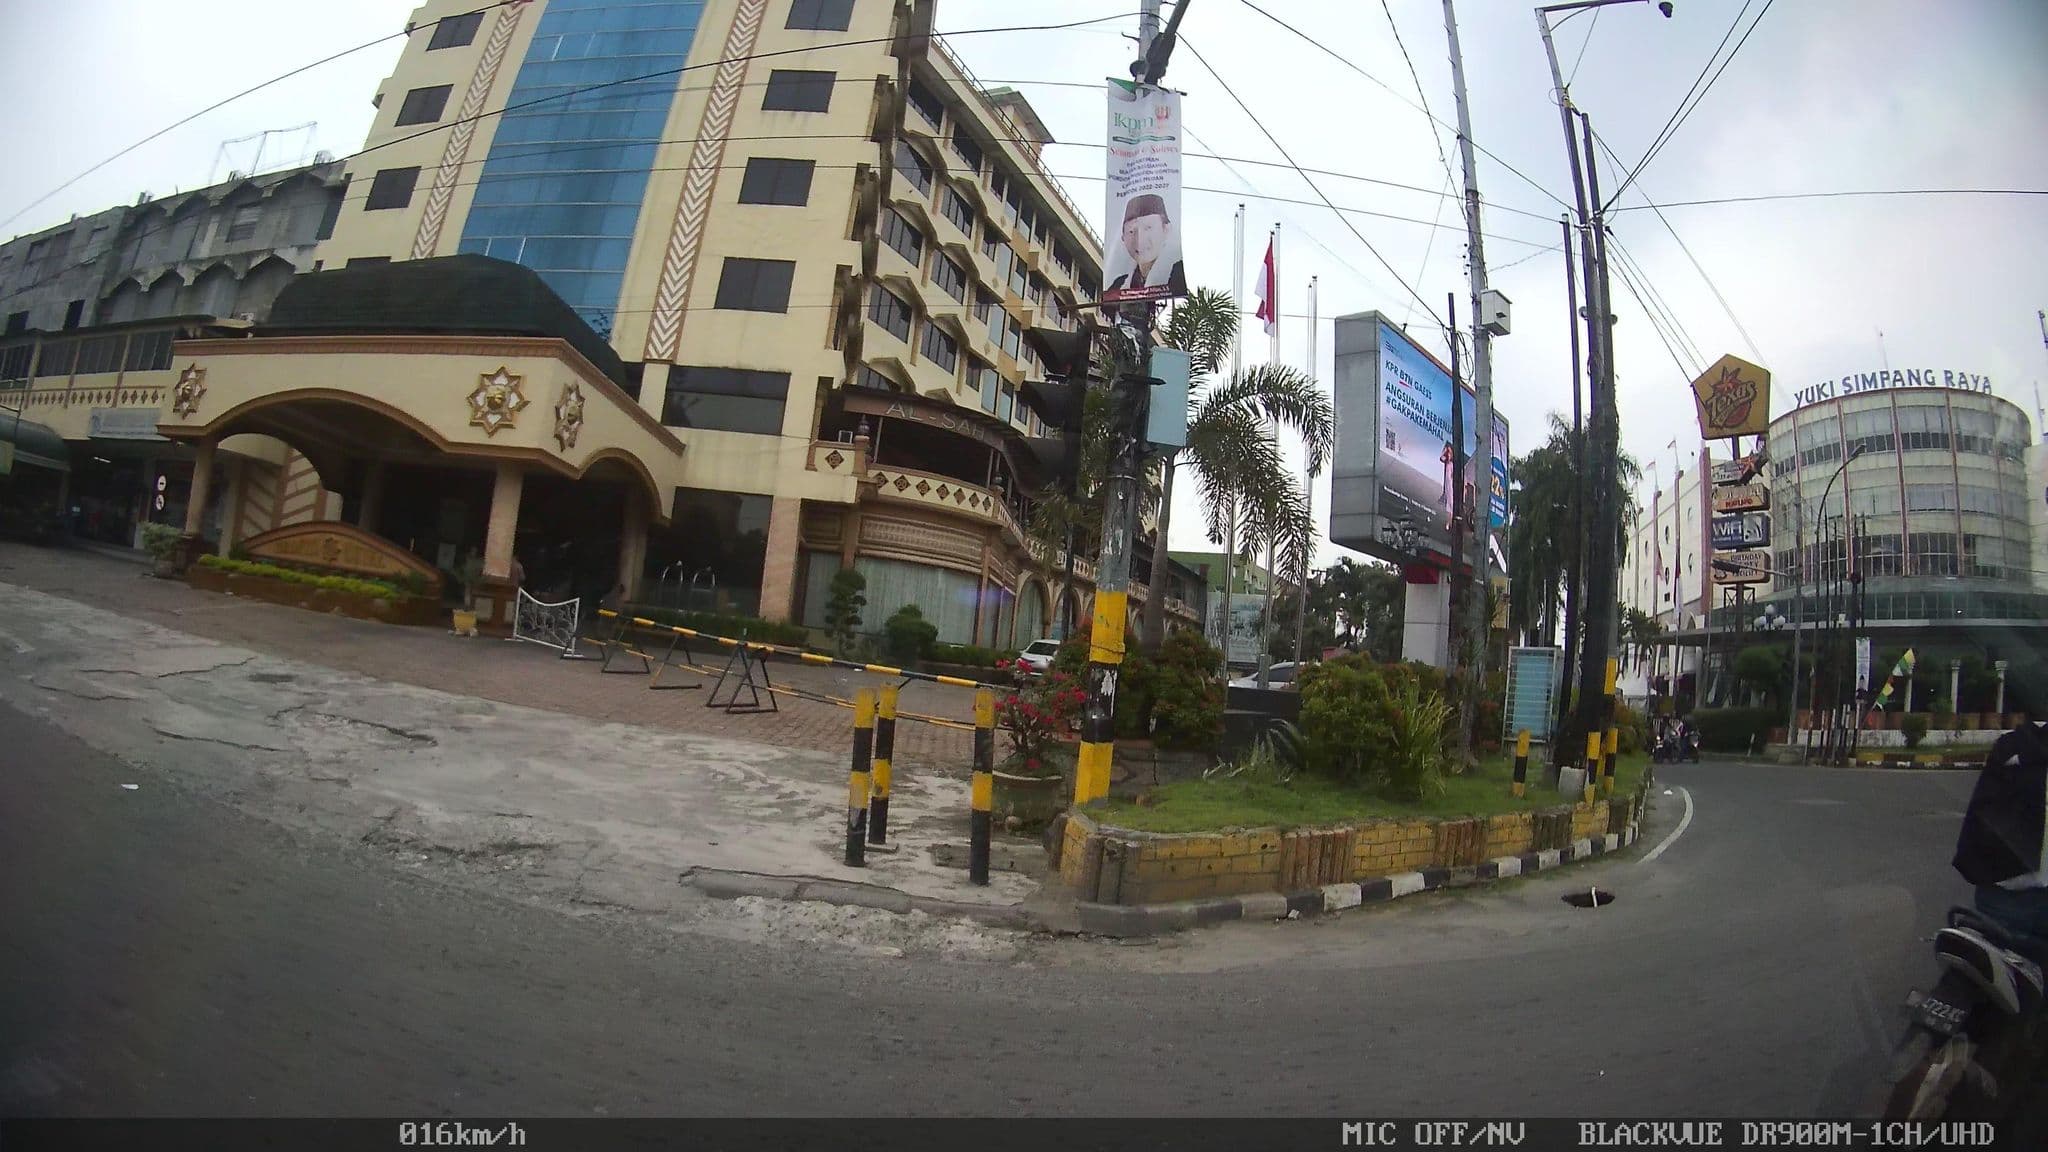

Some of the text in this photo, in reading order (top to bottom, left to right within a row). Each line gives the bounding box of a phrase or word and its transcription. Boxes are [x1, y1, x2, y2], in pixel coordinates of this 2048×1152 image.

[1385, 360, 1399, 376] KPR
[1399, 369, 1413, 387] BTN
[1793, 368, 1992, 409] YUKI SIMPANG RAYA
[1385, 381, 1425, 415] ANGSURAN
[1386, 395, 1444, 441] #GAKPAKEMAHAL
